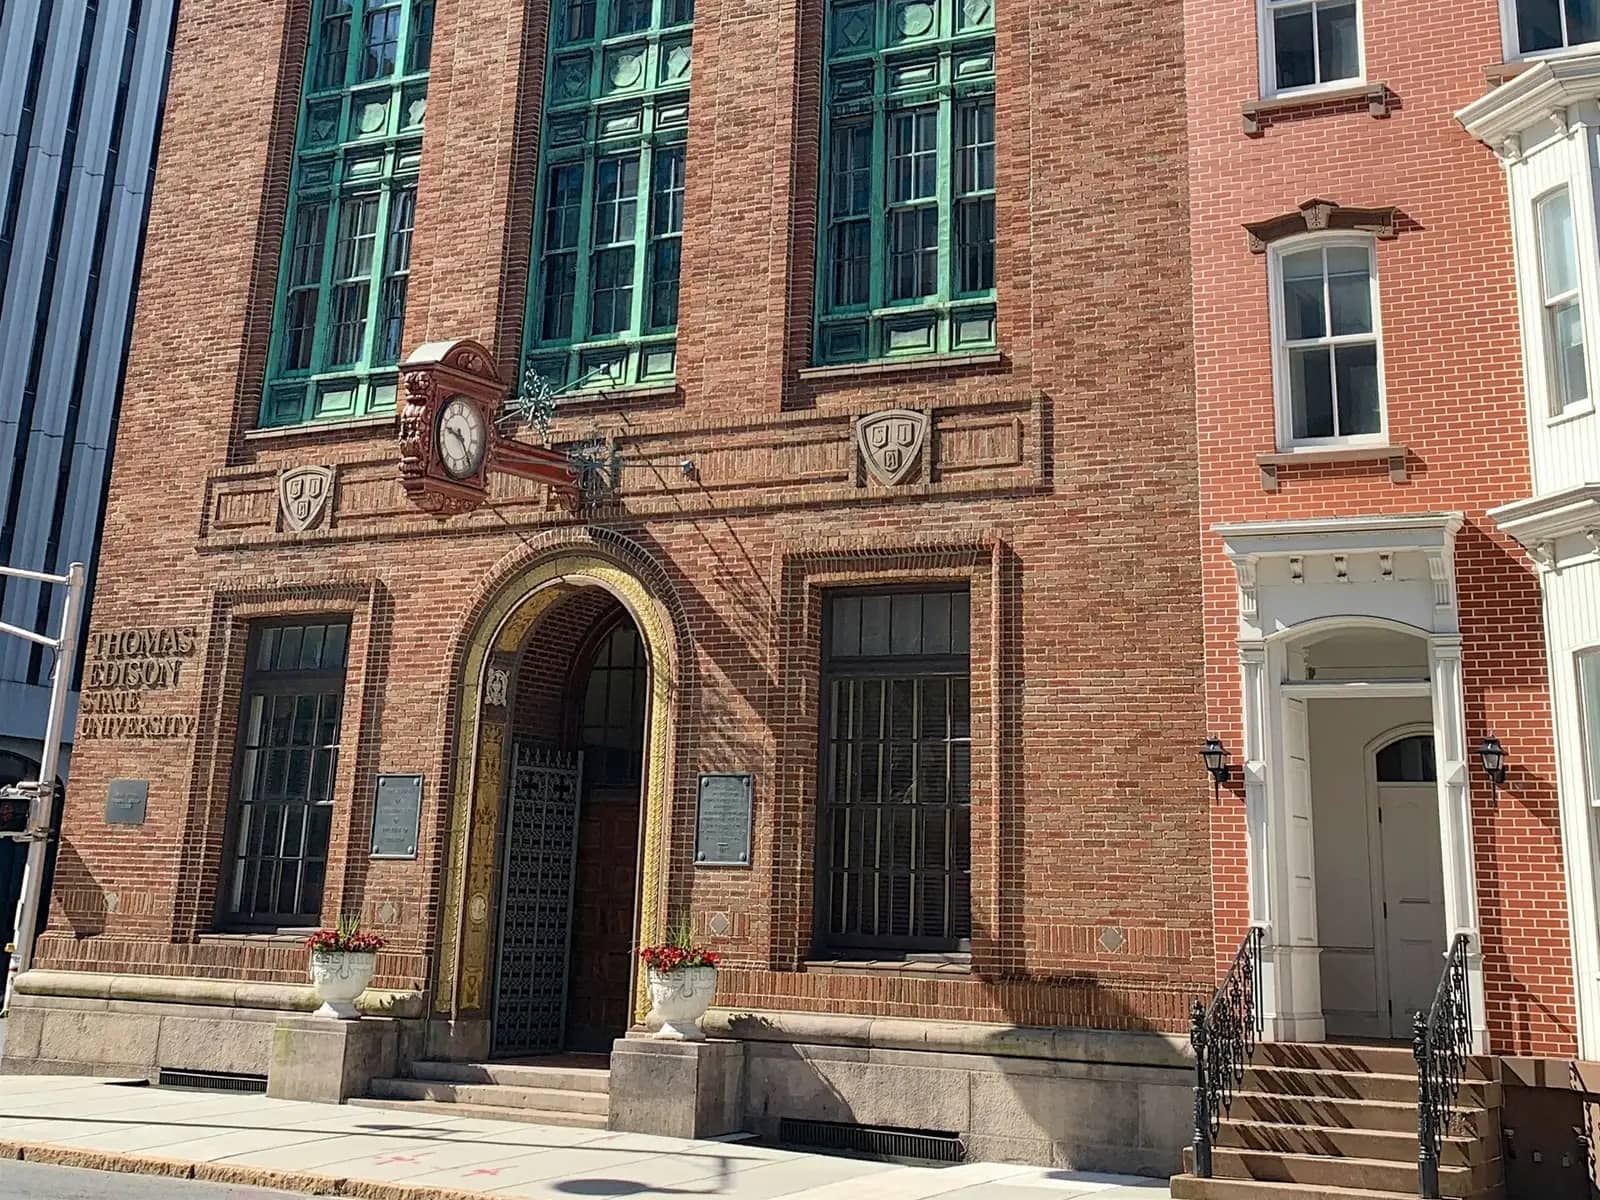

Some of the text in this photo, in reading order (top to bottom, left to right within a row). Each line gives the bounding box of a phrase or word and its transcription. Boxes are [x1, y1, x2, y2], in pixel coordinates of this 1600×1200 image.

[92, 627, 194, 657] THOMAS
[88, 658, 182, 688] EDISON
[80, 689, 140, 714] STATE
[79, 714, 197, 739] UNIVERSITY
